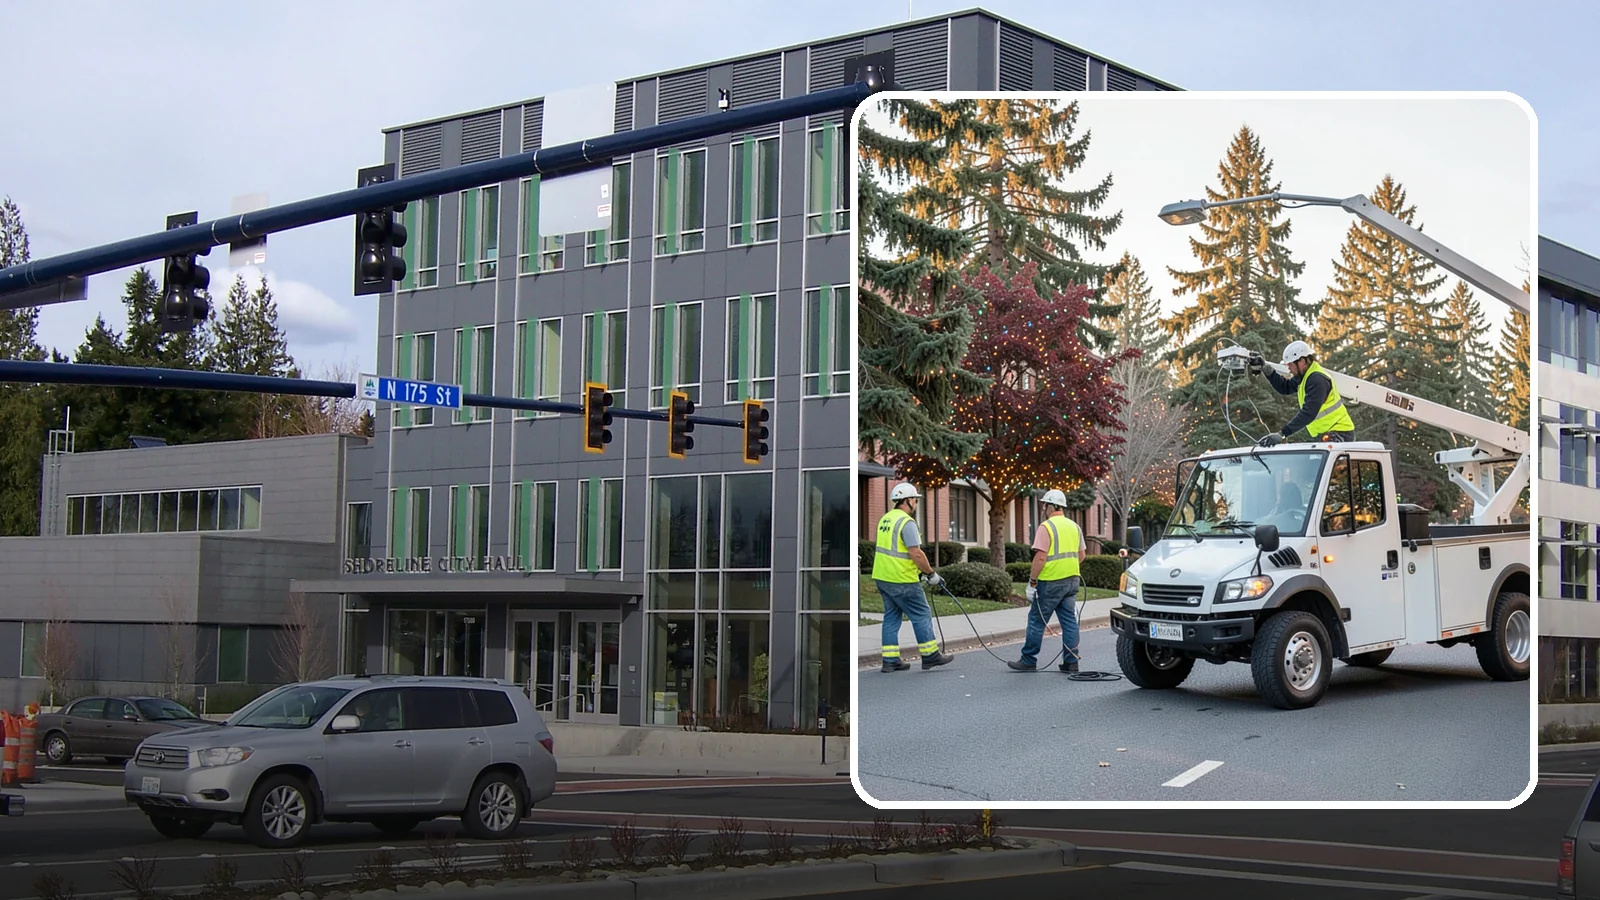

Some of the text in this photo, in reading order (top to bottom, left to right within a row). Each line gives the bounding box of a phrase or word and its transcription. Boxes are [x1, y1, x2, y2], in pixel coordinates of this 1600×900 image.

[387, 380, 451, 406] N 175 St
[344, 556, 525, 574] SHORELINE CITY HALL
